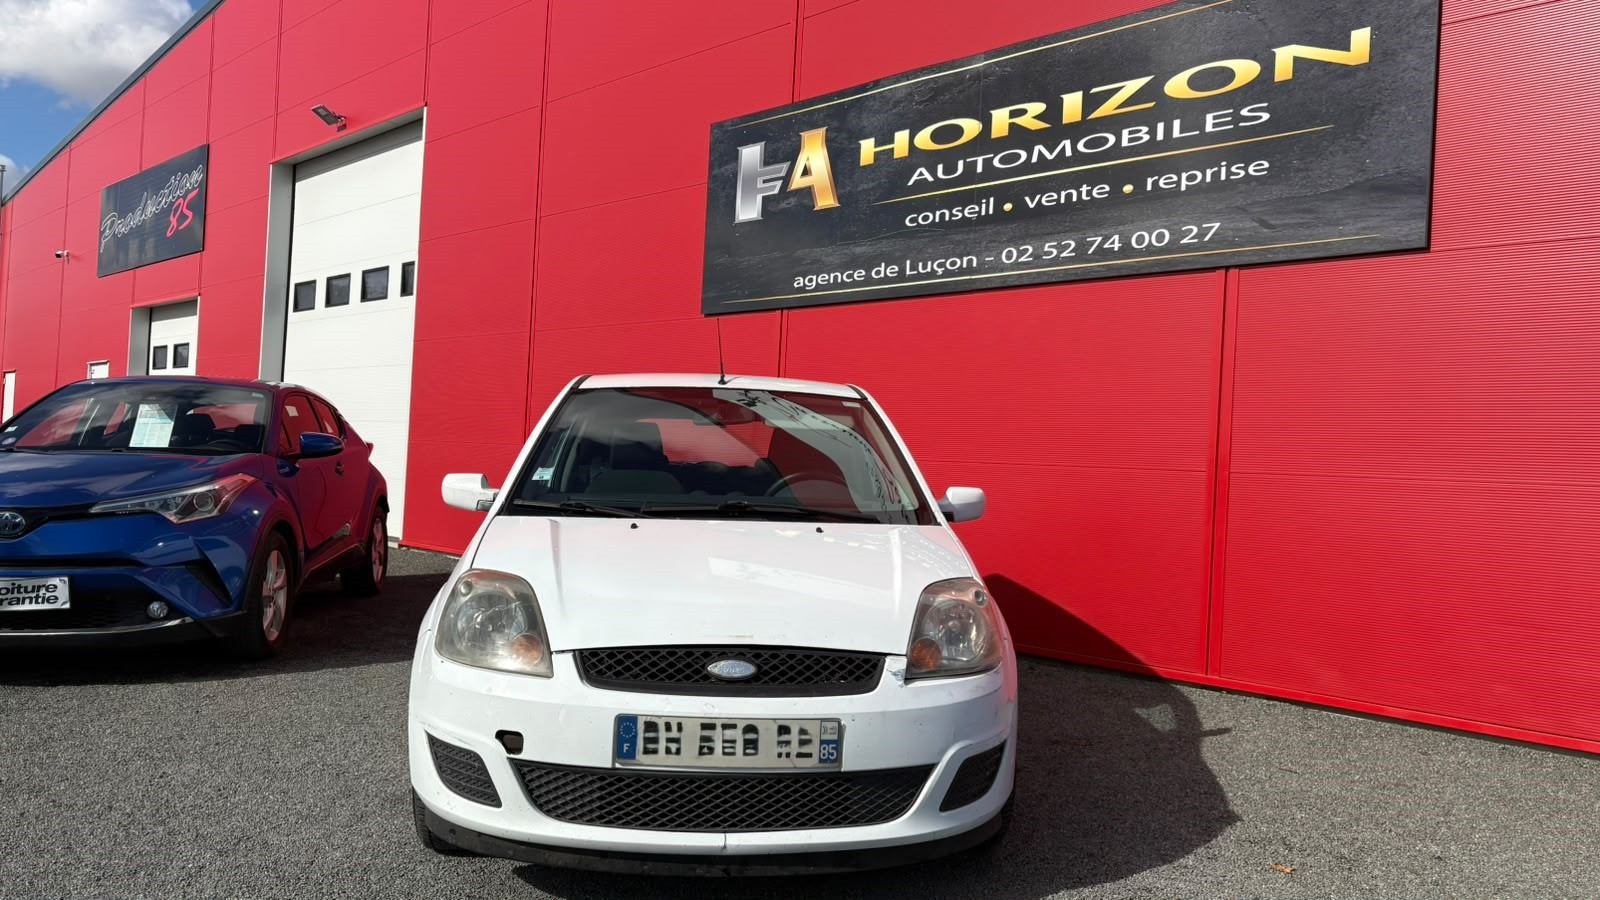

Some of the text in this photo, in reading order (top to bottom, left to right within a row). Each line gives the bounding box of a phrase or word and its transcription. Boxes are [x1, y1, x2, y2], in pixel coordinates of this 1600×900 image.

[859, 27, 1371, 167] HORIZON
[907, 102, 1271, 186] AUTOMOBILES
[166, 188, 200, 237] 85
[905, 160, 1270, 227] conseil vente reprise
[793, 269, 865, 290] agence
[871, 262, 899, 279] de
[905, 253, 978, 277] Luçon
[1001, 246, 1034, 264] 02
[1042, 241, 1076, 259] 52
[1086, 235, 1122, 255] 74
[1131, 229, 1170, 250] 00
[1180, 222, 1221, 244] 27
[0, 582, 58, 596] oiture
[0, 593, 59, 606] rantie
[623, 743, 630, 753] F
[820, 744, 837, 760] 85
